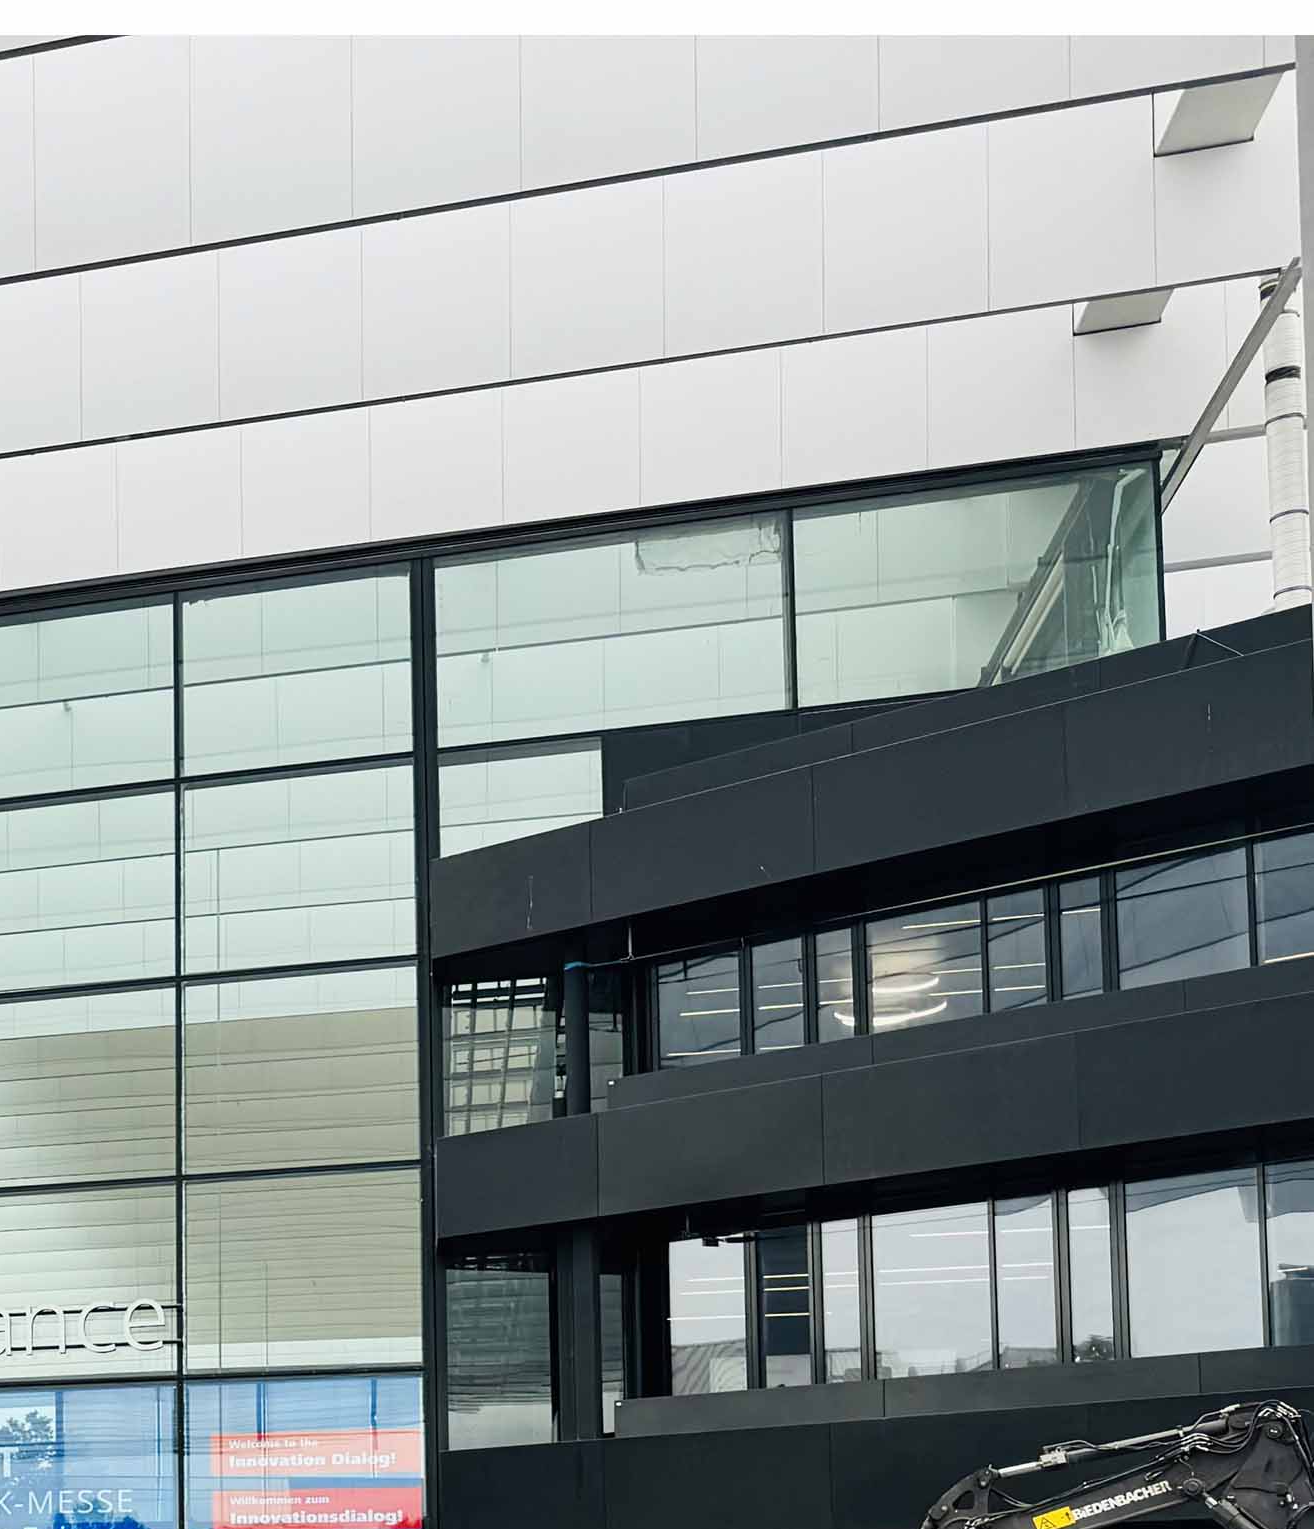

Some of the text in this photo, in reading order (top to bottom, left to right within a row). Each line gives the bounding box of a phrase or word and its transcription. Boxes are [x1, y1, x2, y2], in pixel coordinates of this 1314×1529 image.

[228, 1438, 318, 1450] Welcome to the
[228, 1451, 397, 1468] Innovation Dialog!
[229, 1495, 330, 1506] Willkommen zum
[229, 1509, 403, 1526] Innovationsdialog!
